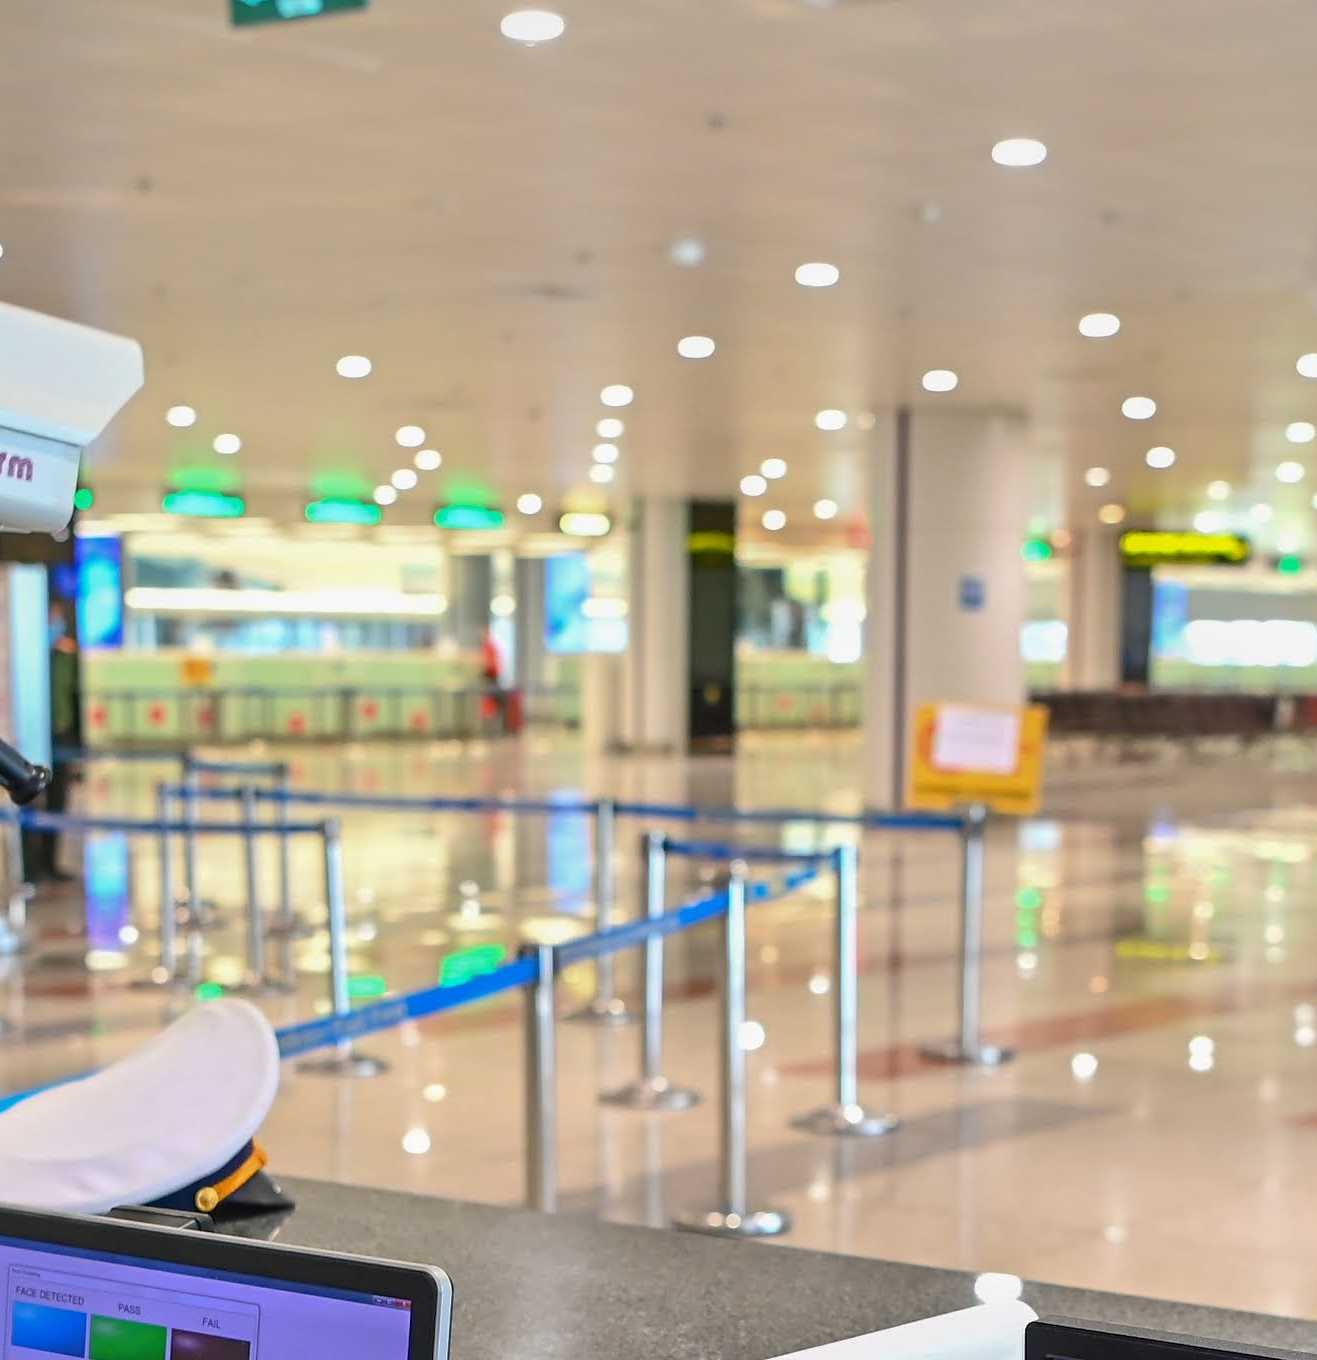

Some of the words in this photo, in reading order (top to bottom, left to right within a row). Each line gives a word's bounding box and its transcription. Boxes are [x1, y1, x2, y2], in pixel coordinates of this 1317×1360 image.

[16, 1286, 37, 1298] FACE
[40, 1290, 85, 1306] DETECTED
[118, 1303, 141, 1315] PASS
[202, 1317, 221, 1329] FAIL
